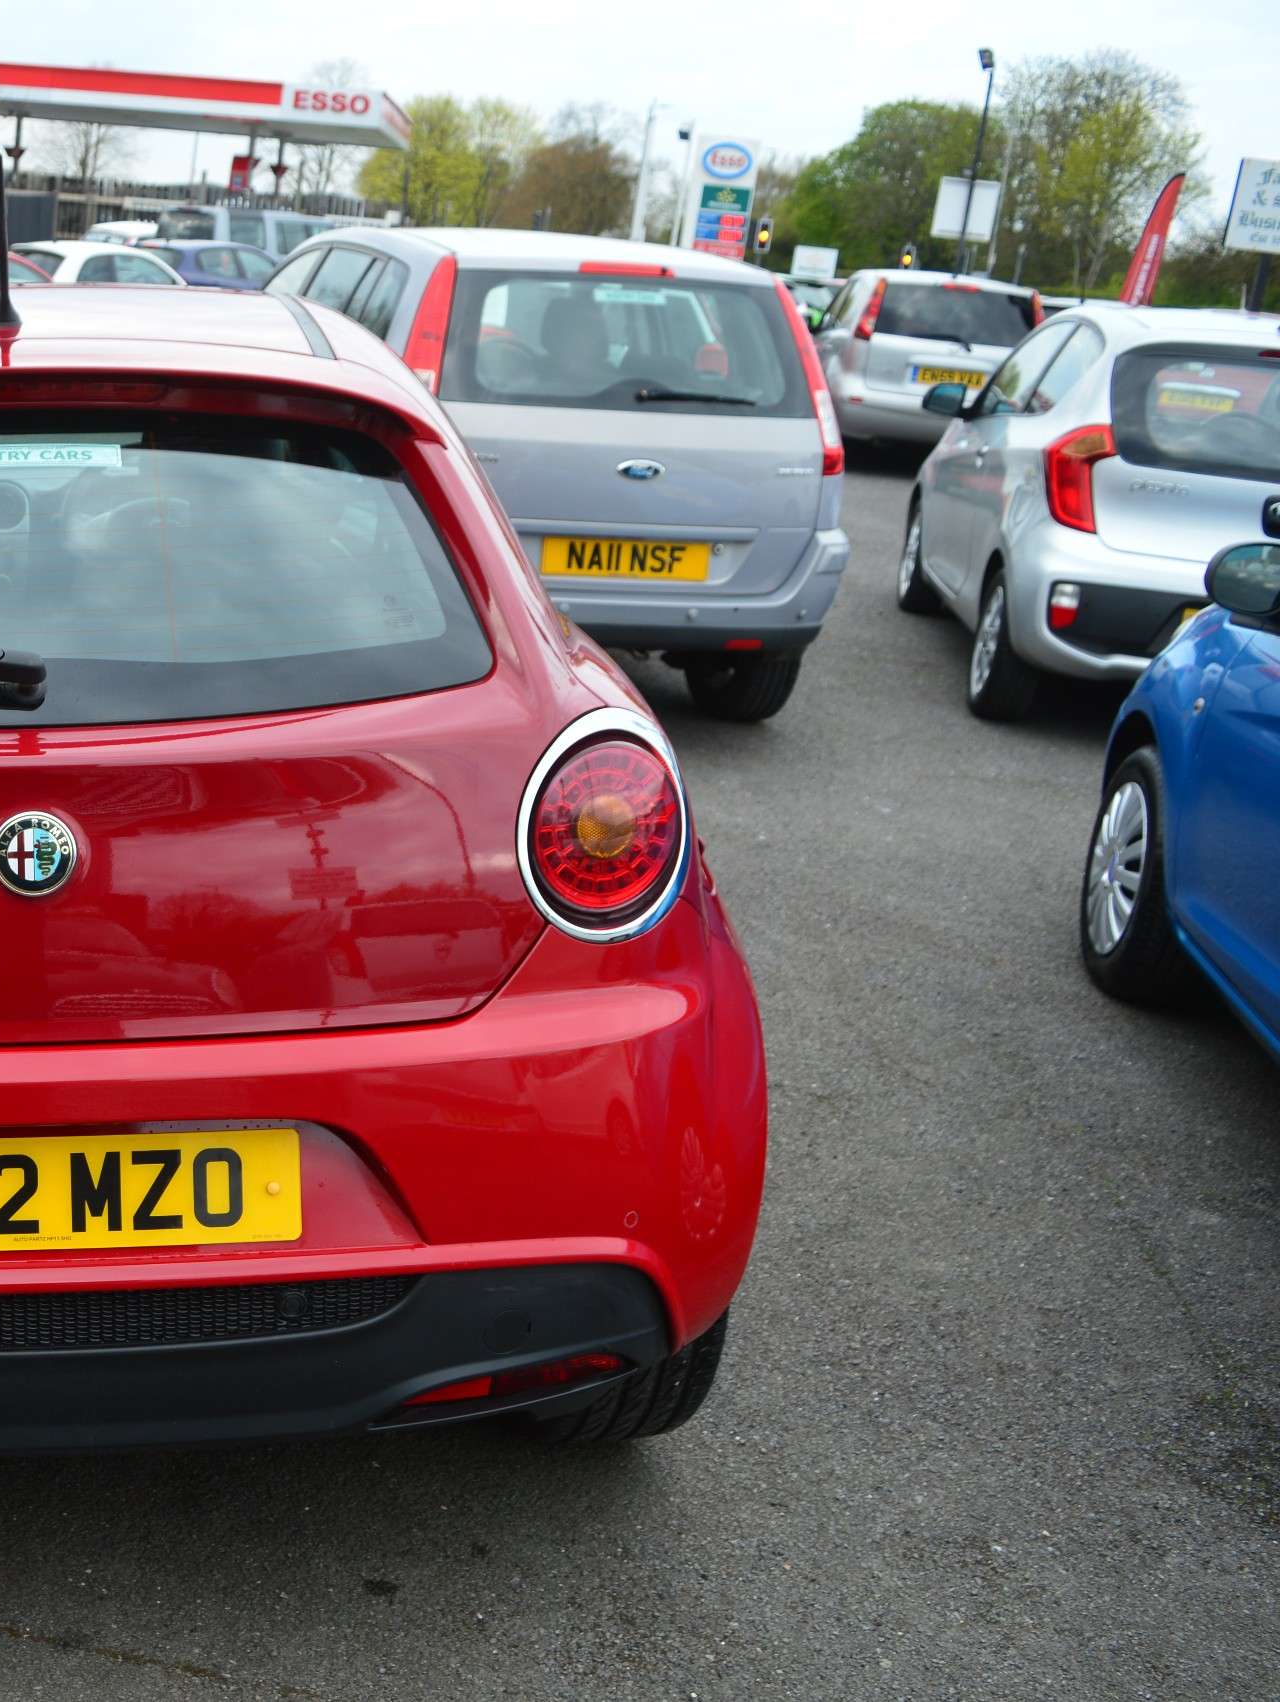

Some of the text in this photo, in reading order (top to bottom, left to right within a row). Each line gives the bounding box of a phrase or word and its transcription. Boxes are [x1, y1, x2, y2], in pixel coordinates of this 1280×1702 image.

[293, 90, 370, 115] ESSO
[40, 450, 93, 461] CARS
[567, 541, 686, 574] NA11 NSF
[31, 818, 70, 855] ROMEO
[70, 1147, 243, 1233] MZO
